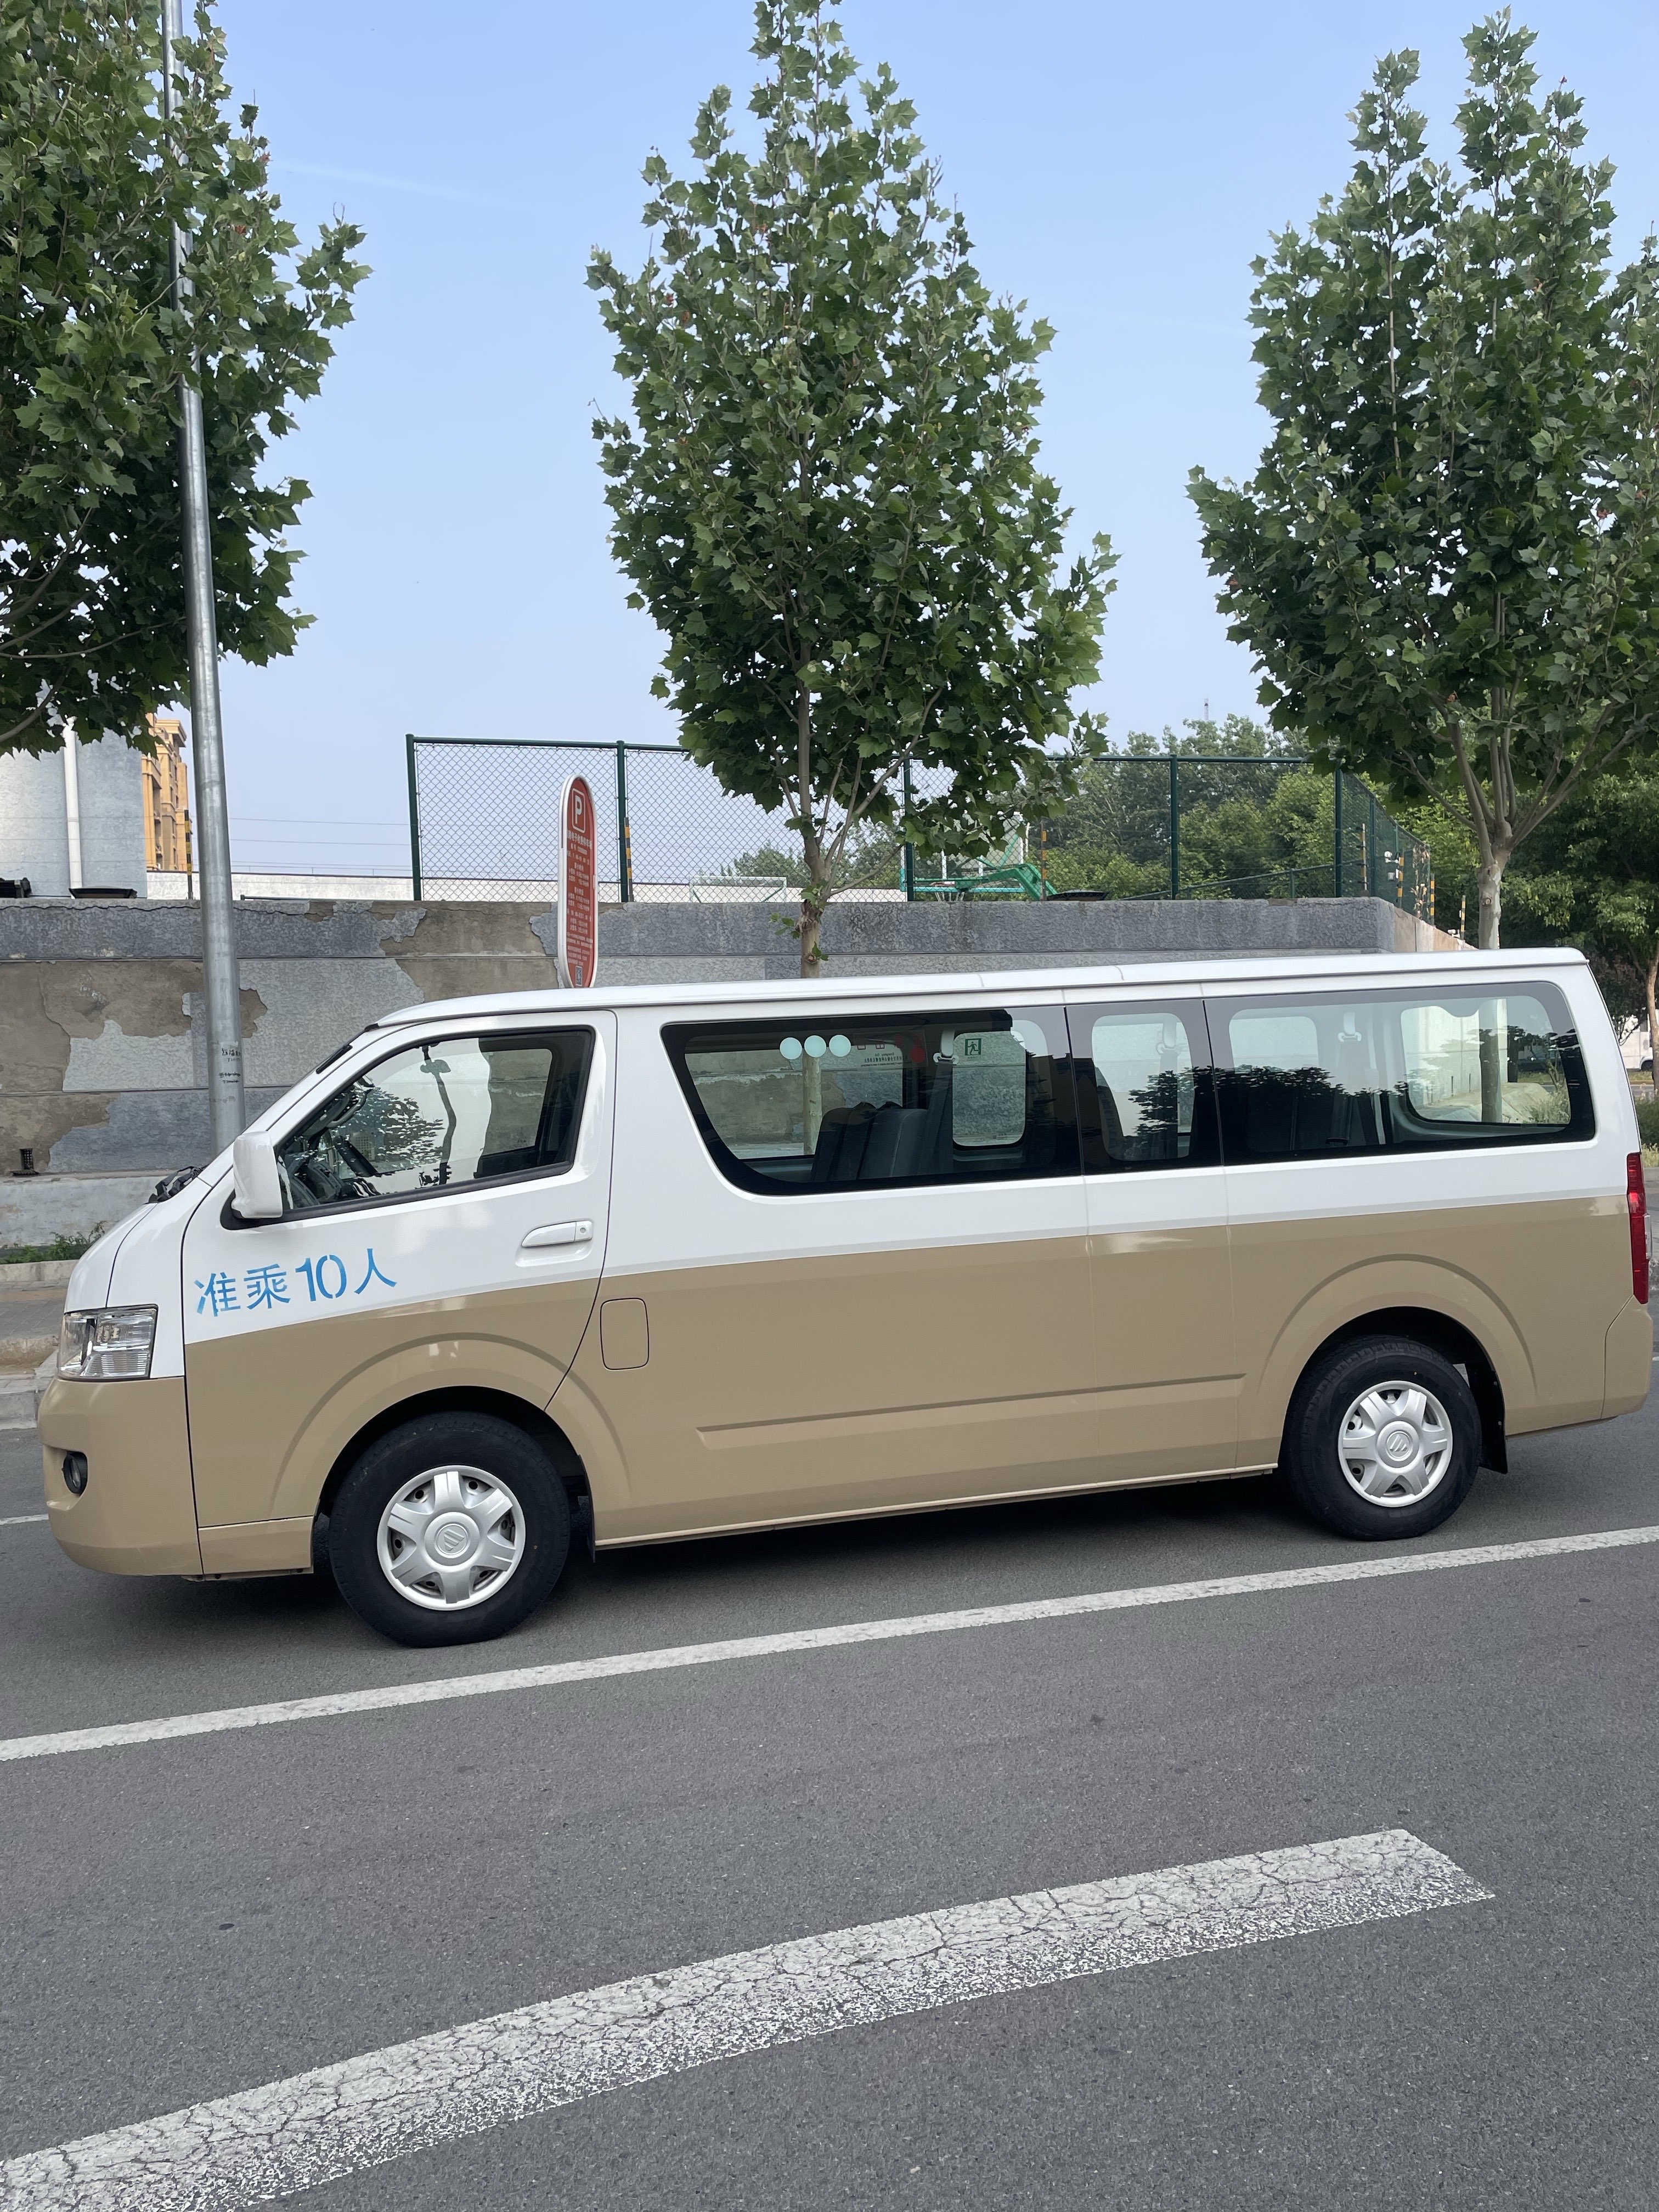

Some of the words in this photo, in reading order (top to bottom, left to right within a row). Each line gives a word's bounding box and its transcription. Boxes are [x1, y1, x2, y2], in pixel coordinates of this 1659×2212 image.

[574, 794, 583, 825] P
[194, 1248, 398, 1317] 准乘10人
